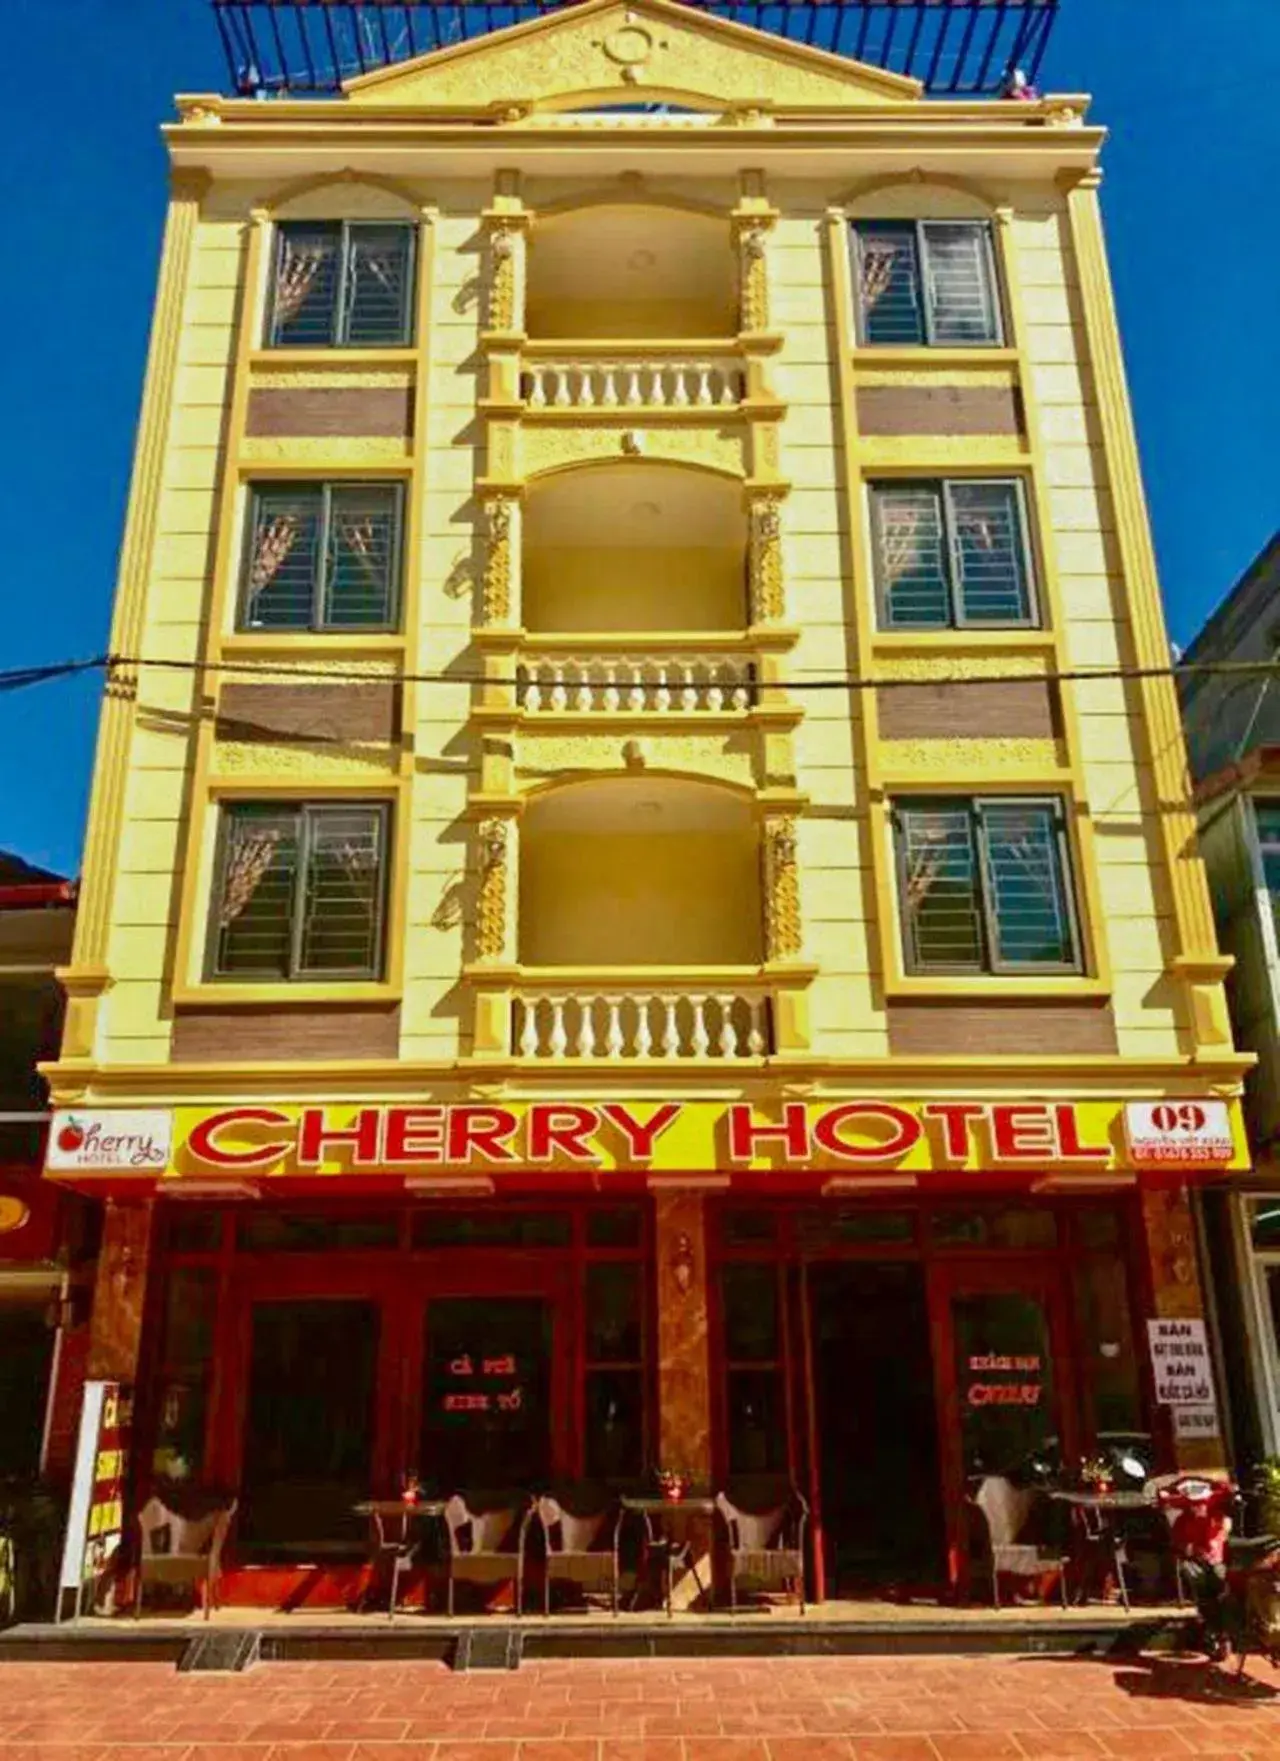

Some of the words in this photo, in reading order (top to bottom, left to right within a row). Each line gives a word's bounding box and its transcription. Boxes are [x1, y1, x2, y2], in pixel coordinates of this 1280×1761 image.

[1151, 1104, 1206, 1131] 09
[188, 1105, 681, 1166] CHERRY
[726, 1101, 1113, 1162] HOTEL
[77, 1152, 126, 1164] HOTEL
